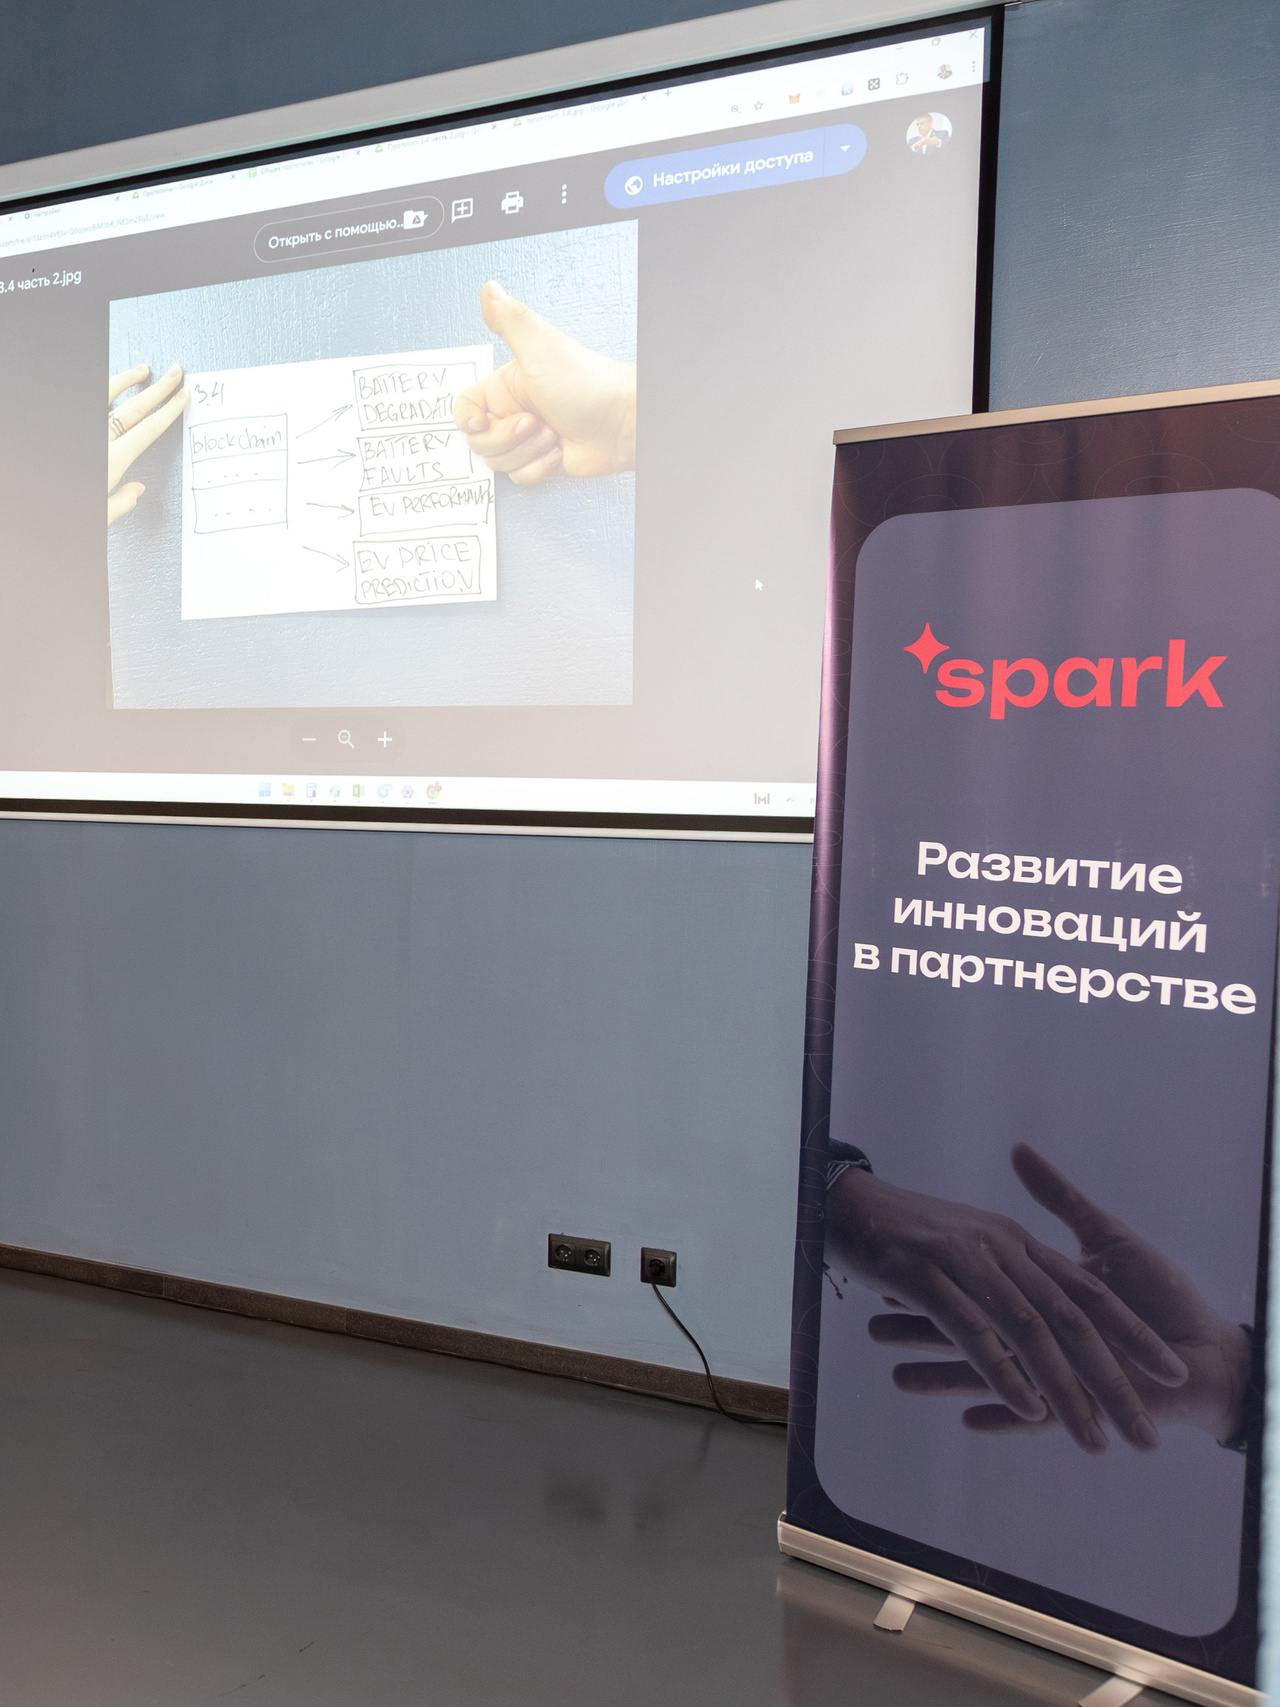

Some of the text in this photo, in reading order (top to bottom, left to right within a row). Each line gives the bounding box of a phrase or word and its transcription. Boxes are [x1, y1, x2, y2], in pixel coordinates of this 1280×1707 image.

[653, 151, 814, 187] Настройки доступа
[268, 230, 322, 249] Открыть
[324, 229, 333, 240] с
[18, 276, 50, 290] часть
[53, 270, 82, 287] 2.jpg
[358, 368, 447, 400] BATTERY
[364, 433, 451, 462] BATTERY
[364, 461, 444, 485] FAULTS
[370, 496, 395, 516] EV
[357, 550, 390, 574] EV
[935, 639, 1228, 720] spark
[917, 841, 1183, 894] Развитие
[893, 896, 1208, 953] инноваций
[852, 944, 1257, 1015] в партнерстве
